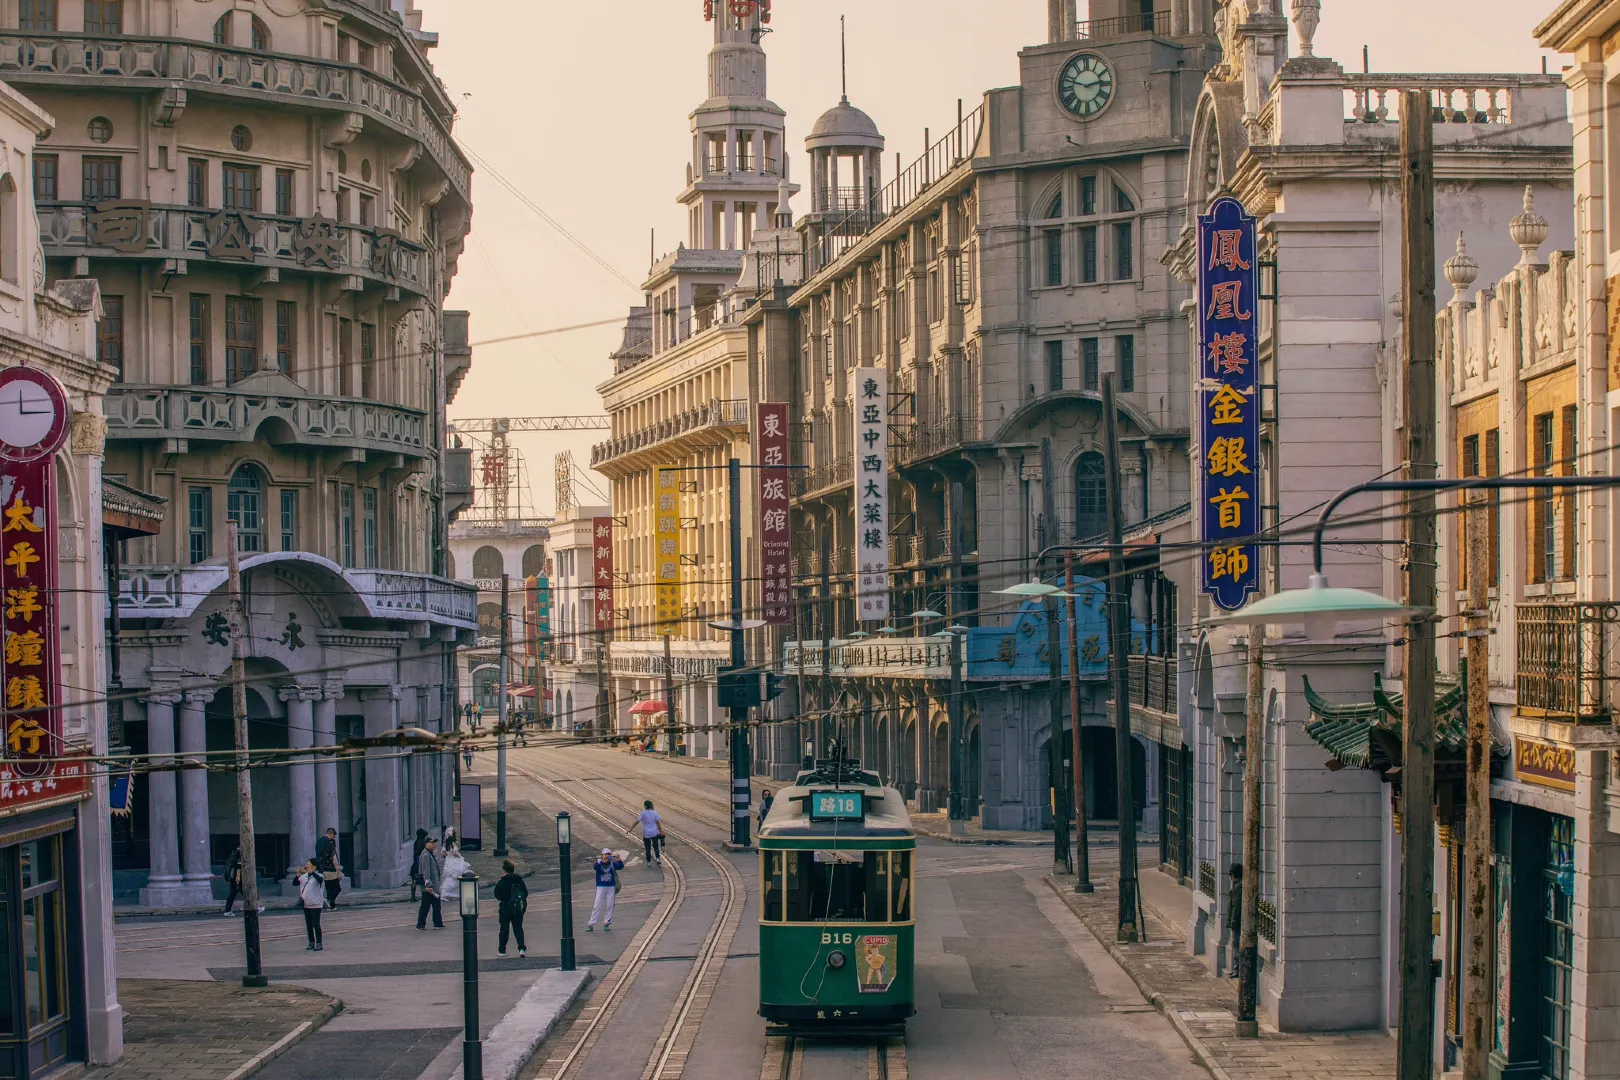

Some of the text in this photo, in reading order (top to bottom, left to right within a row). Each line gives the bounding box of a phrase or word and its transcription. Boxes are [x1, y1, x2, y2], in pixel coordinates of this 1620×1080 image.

[861, 378, 883, 549] 東亞中西大菜樓
[762, 413, 787, 533] 東亞旅館
[763, 540, 789, 548] Oriental
[767, 548, 785, 556] Hotel
[596, 524, 611, 621] 新新大旅館
[822, 933, 852, 944] B16
[864, 936, 888, 944] CUPID
